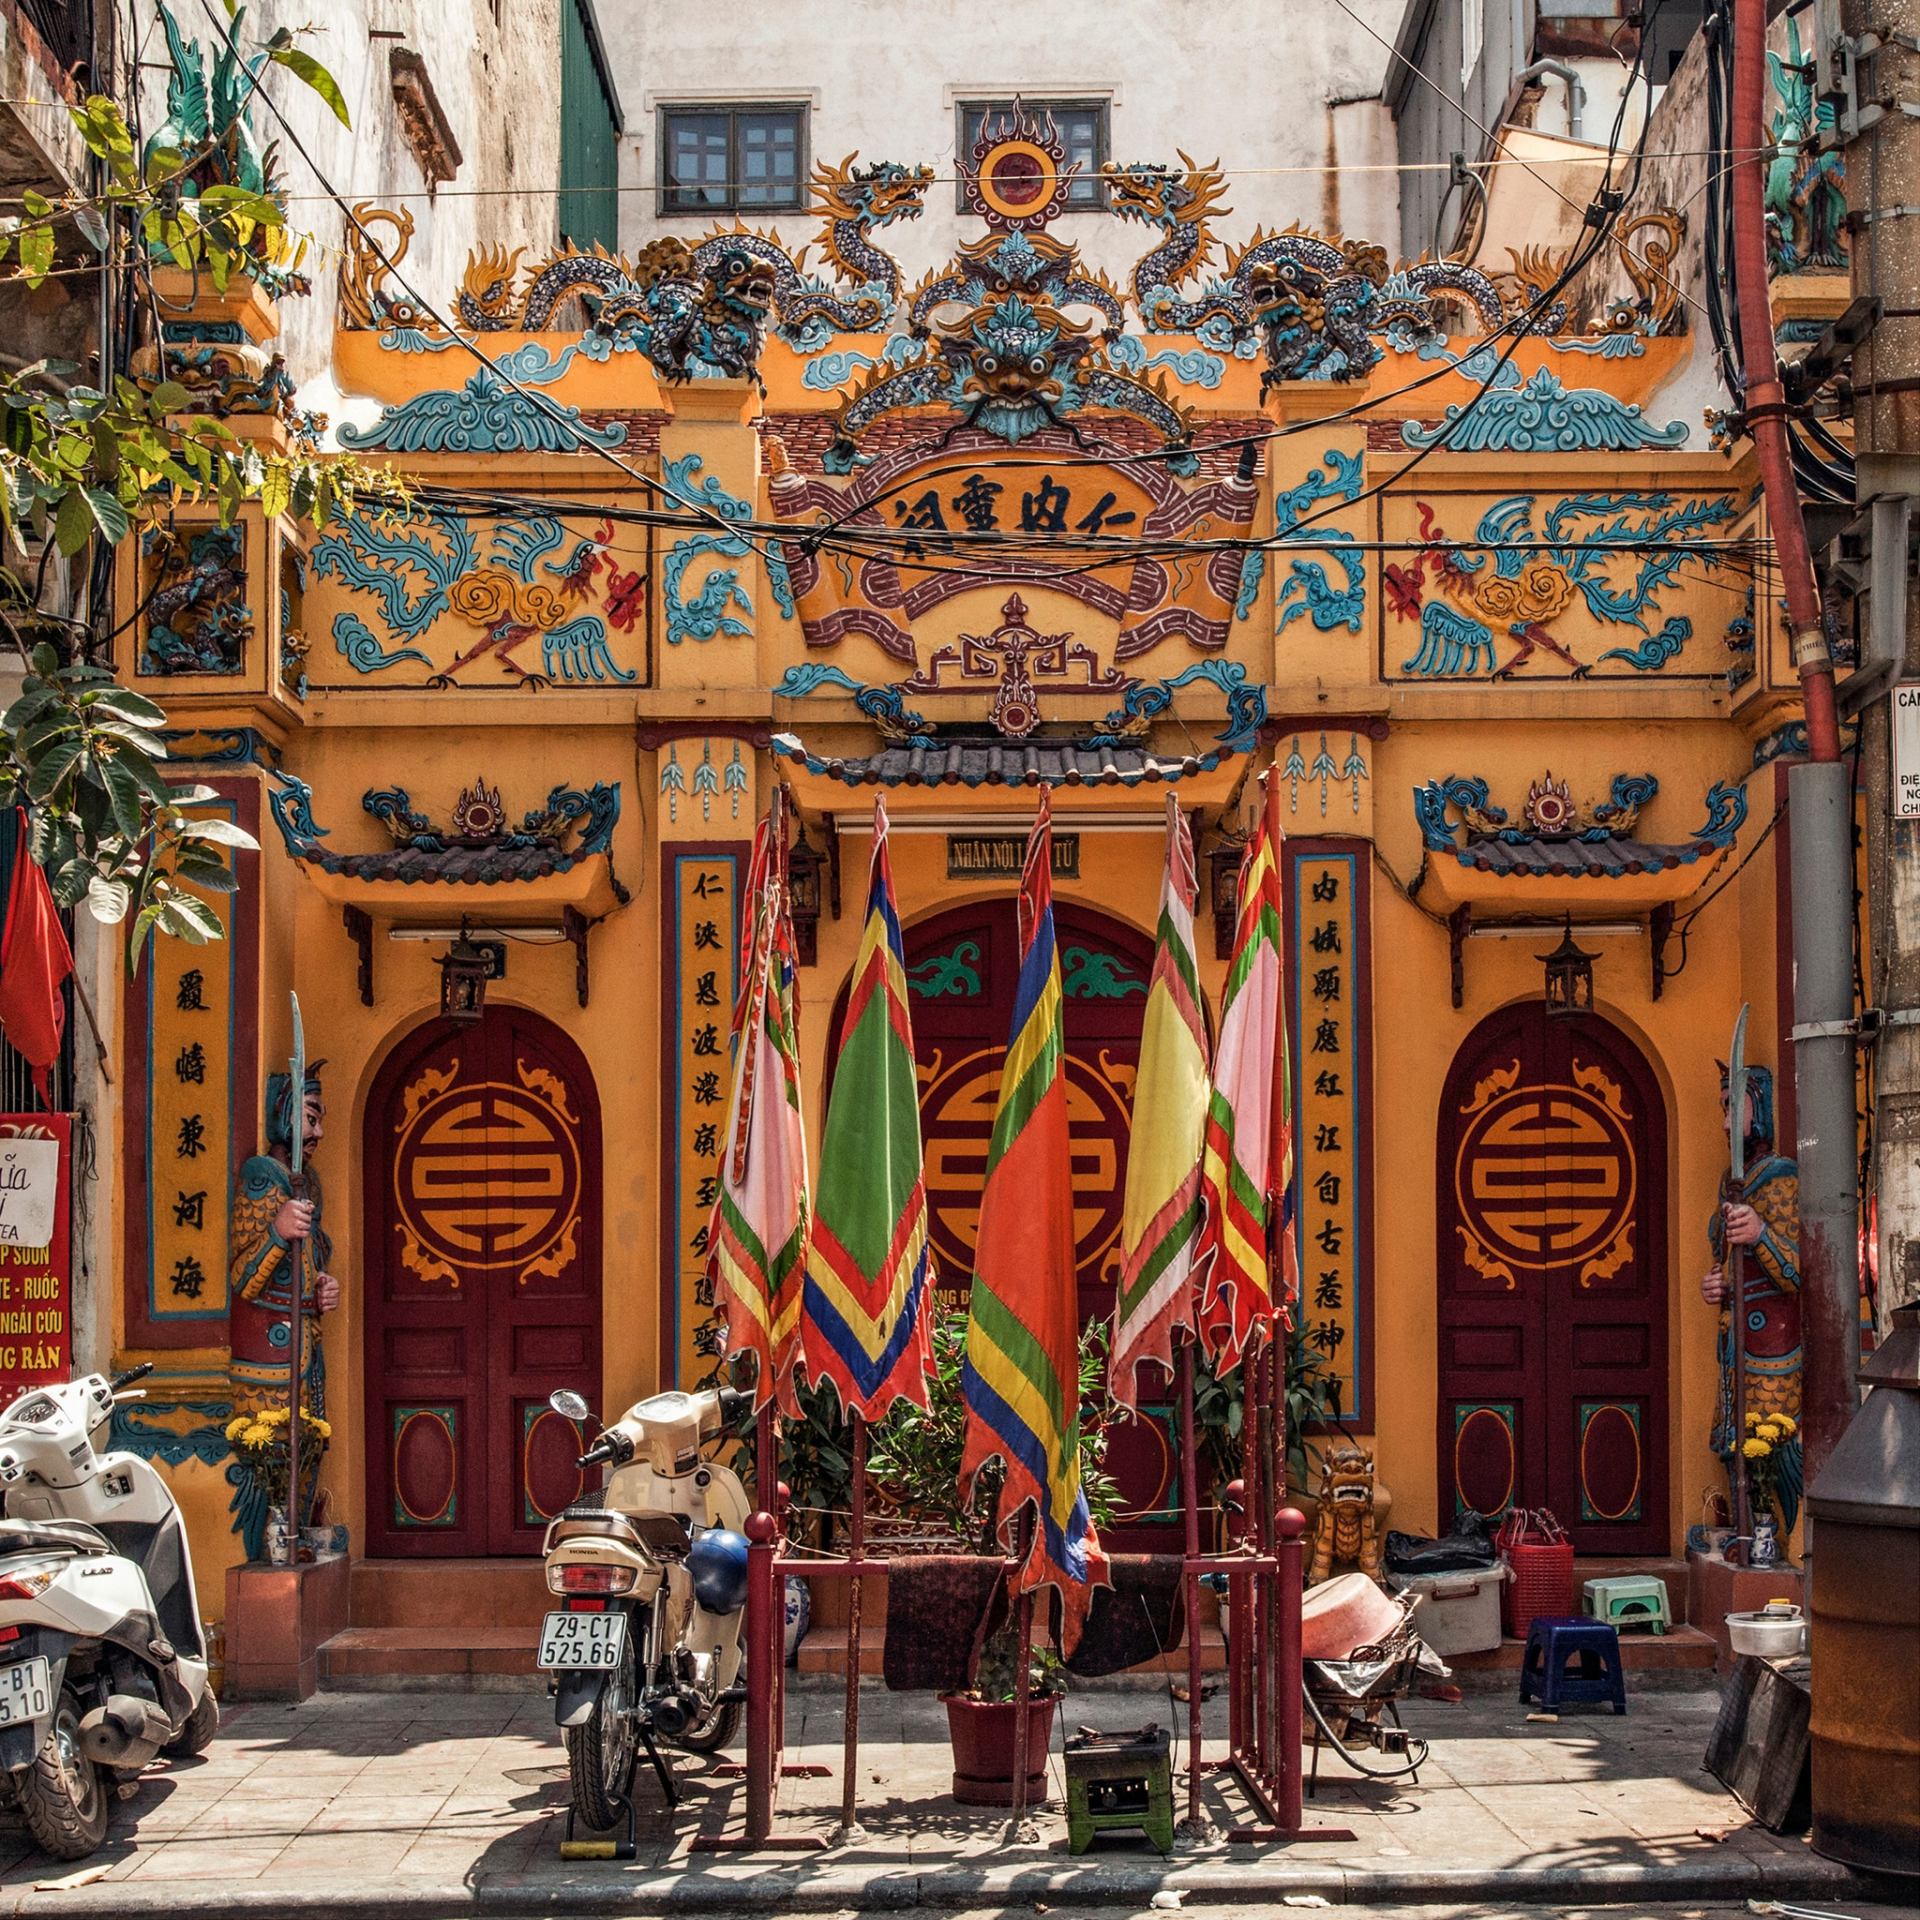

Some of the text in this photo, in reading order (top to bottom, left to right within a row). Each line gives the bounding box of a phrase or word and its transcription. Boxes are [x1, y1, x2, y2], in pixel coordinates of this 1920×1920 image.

[954, 840, 991, 868] NHÂN
[993, 840, 1015, 871] NỘI
[24, 1270, 60, 1300] RUỐC
[0, 1305, 62, 1334] NGẢI CỨU
[21, 1340, 60, 1370] RÁN
[554, 1617, 612, 1639] 29-C1
[544, 1641, 617, 1665] 525.66
[0, 1689, 45, 1722] 5.10
